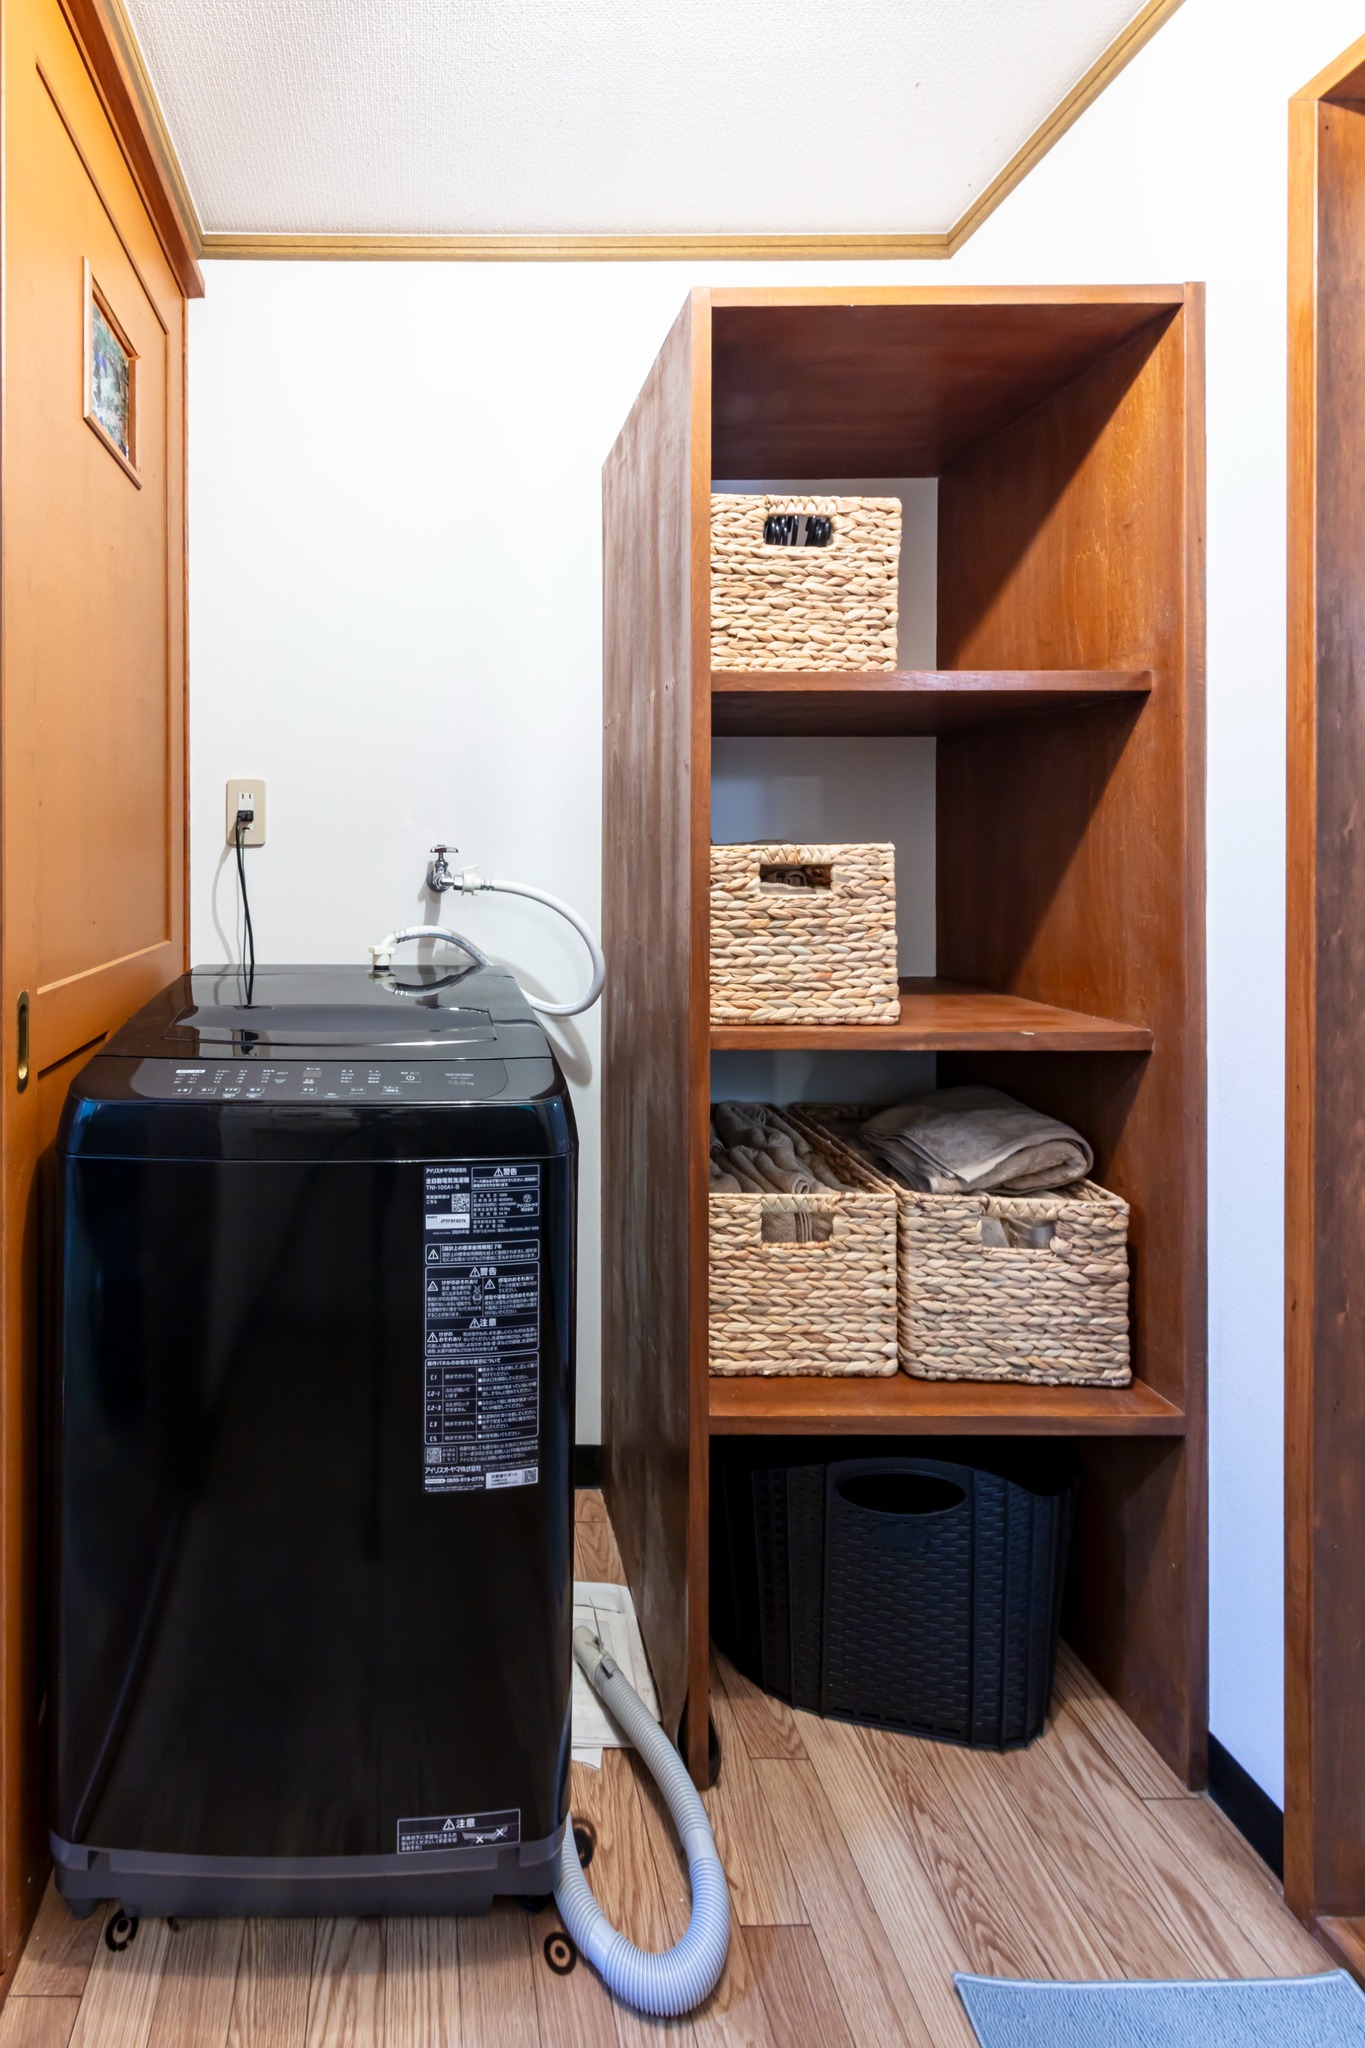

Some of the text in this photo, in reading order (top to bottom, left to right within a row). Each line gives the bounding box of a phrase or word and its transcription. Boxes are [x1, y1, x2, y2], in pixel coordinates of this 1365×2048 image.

[480, 1267, 496, 1276] 警告
[480, 1318, 496, 1327] 注意
[425, 1465, 481, 1474] アイリスオーヤマ株式会社
[456, 1818, 475, 1828] 注意
